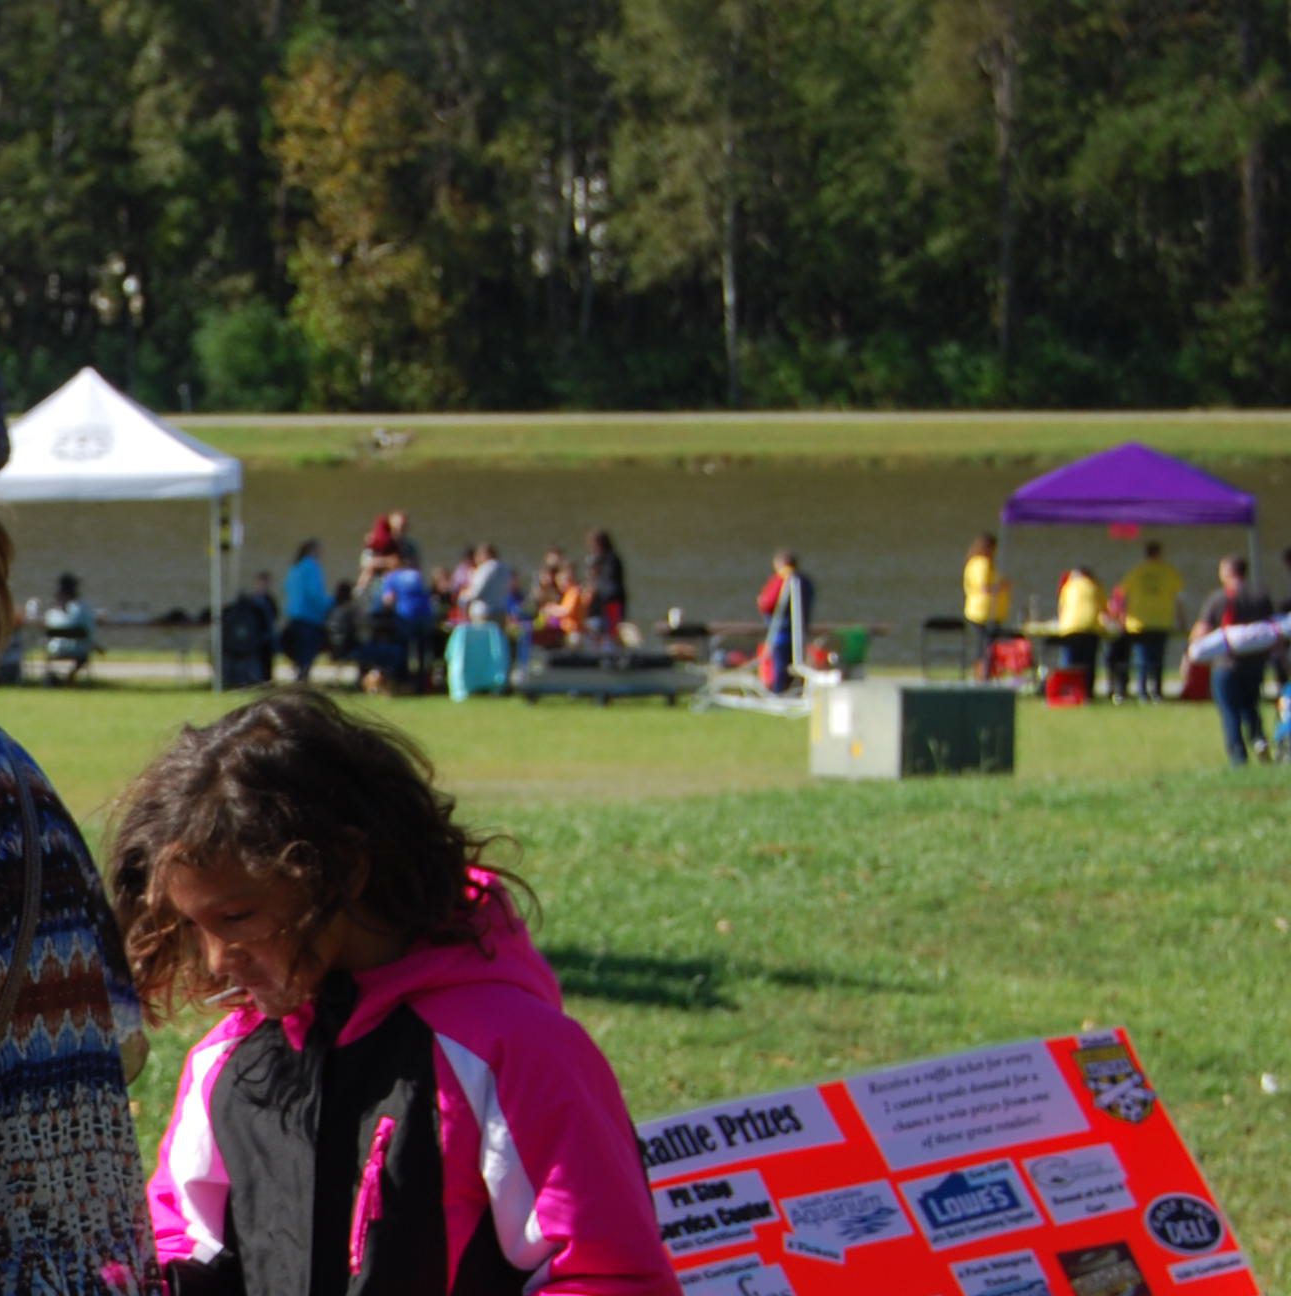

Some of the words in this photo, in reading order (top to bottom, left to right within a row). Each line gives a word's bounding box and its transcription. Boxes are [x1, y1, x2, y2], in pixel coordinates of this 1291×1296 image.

[923, 1065, 953, 1083] raffle
[986, 1056, 1004, 1073] for
[714, 1104, 803, 1147] Prizes
[694, 1180, 734, 1203] Stop
[789, 1188, 883, 1230] Aquarium
[928, 1183, 1011, 1223] LOWE'S
[661, 1212, 717, 1241] ervice
[717, 1200, 774, 1227] Center
[1164, 1216, 1213, 1245] DELI
